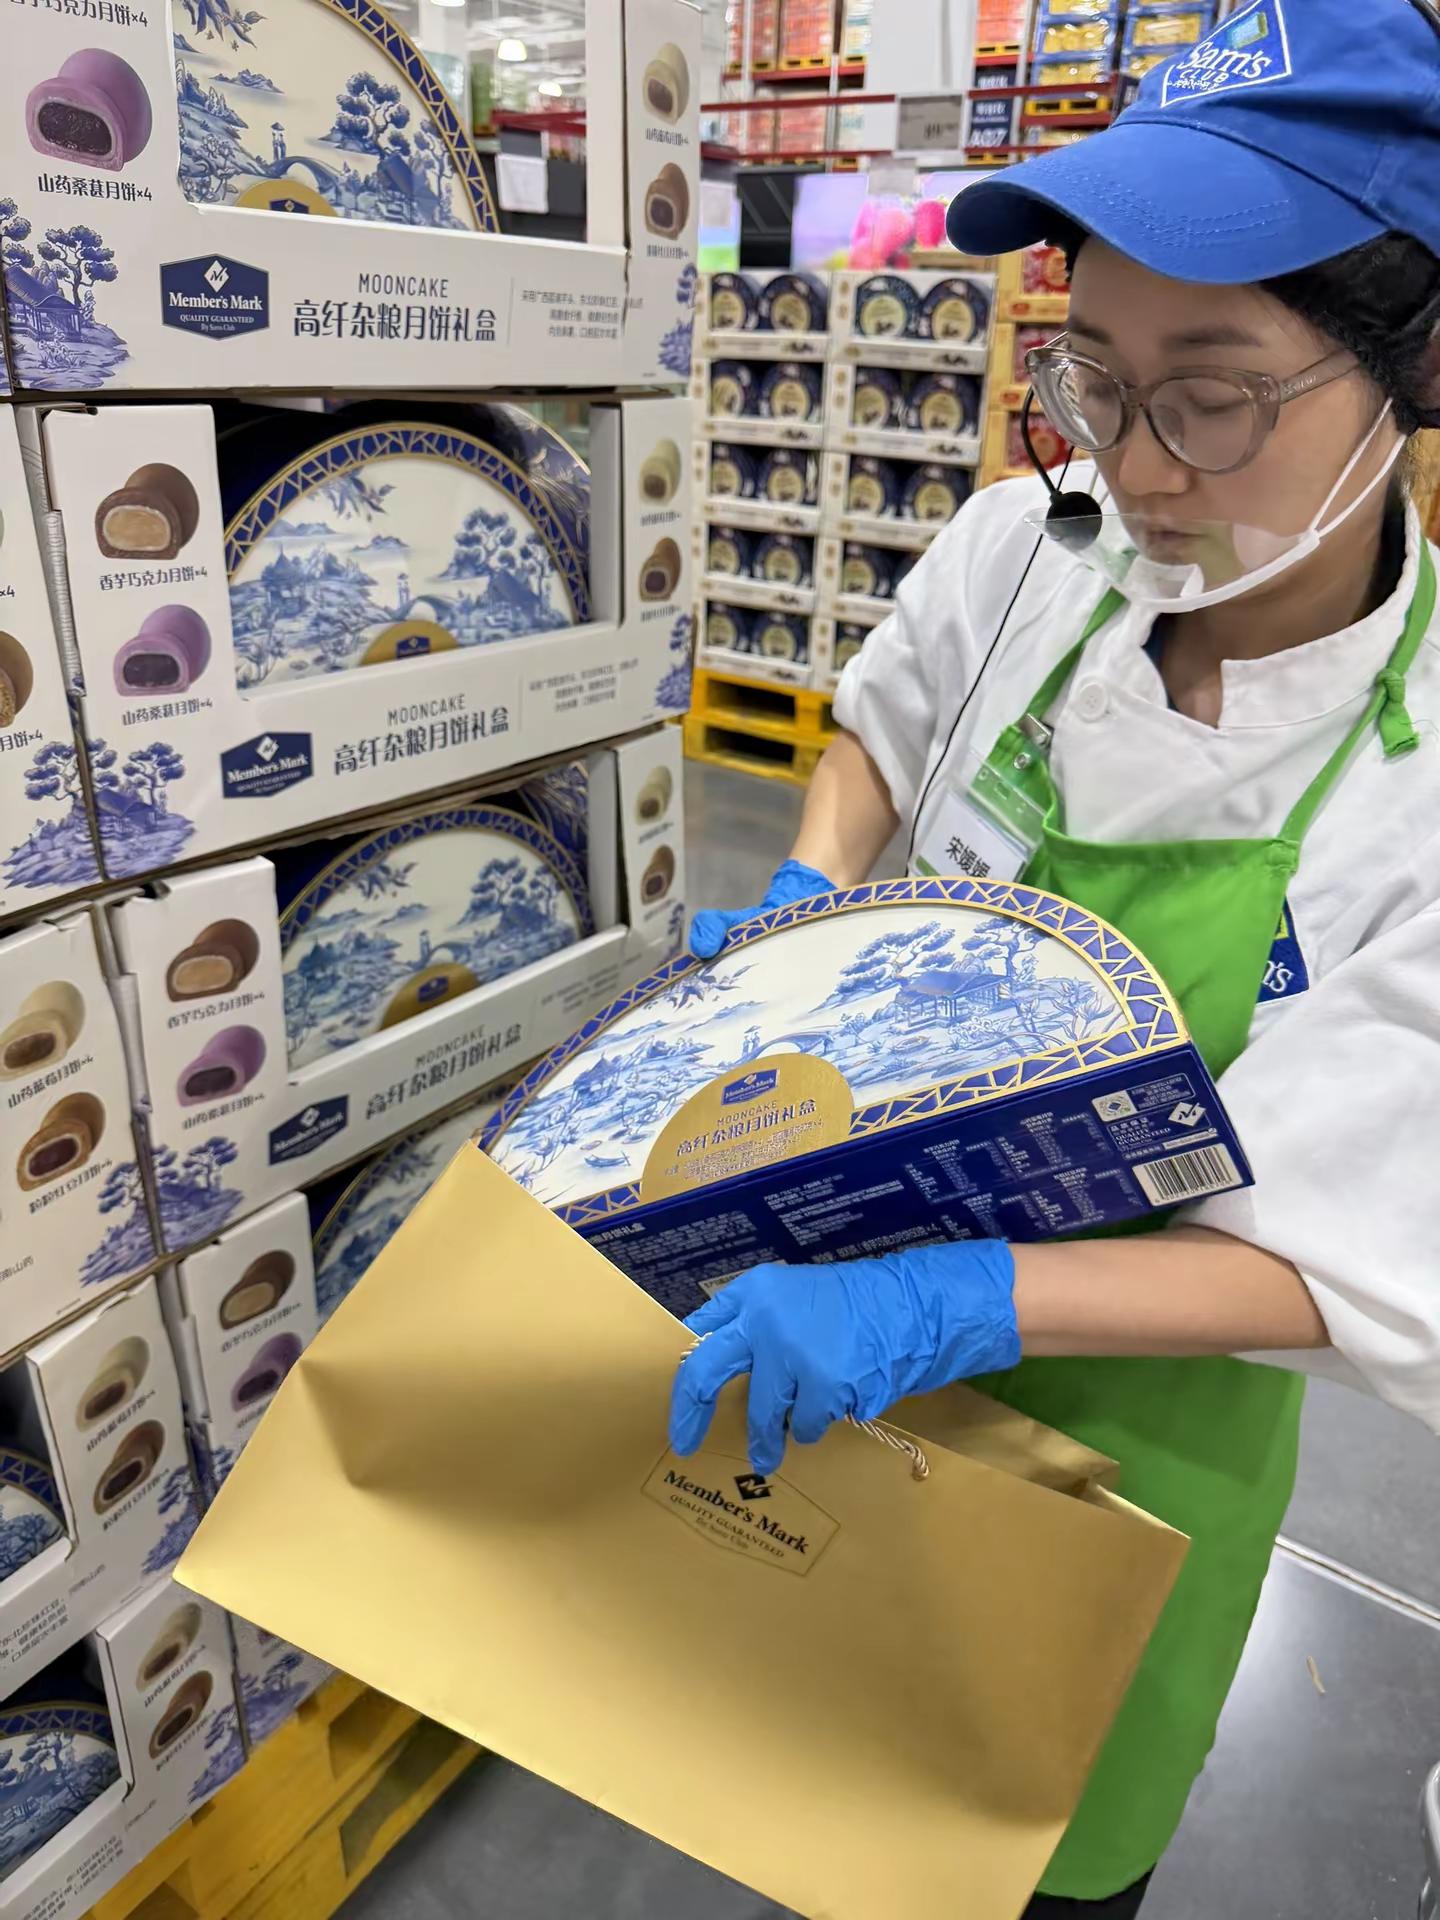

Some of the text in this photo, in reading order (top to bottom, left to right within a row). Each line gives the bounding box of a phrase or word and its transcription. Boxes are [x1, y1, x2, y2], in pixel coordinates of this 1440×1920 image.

[11, 0, 149, 27] 巧克力月饼×4
[1176, 39, 1272, 79] Sam's
[1179, 69, 1229, 84] CLUB
[168, 291, 264, 311] Member's Mark
[358, 273, 449, 298] MOONCAKE
[179, 313, 255, 324] QUALITY GUARANTEED
[293, 299, 497, 343] 高纤杂粮月饼礼盒
[100, 565, 208, 591] 香芋巧克力月饼×4
[388, 694, 466, 727] MOONCAKE
[333, 706, 509, 776] 高纤杂粮月饼礼盒
[226, 752, 309, 785] Member's Mark
[415, 1023, 485, 1069] MOONCAKE
[676, 1099, 817, 1157] 高纤杂粮月饼礼盒
[716, 1099, 777, 1127] MOONCAKE
[663, 1469, 810, 1555] Member's Mark
[670, 1494, 785, 1558] QUALITY GUARANTEED
